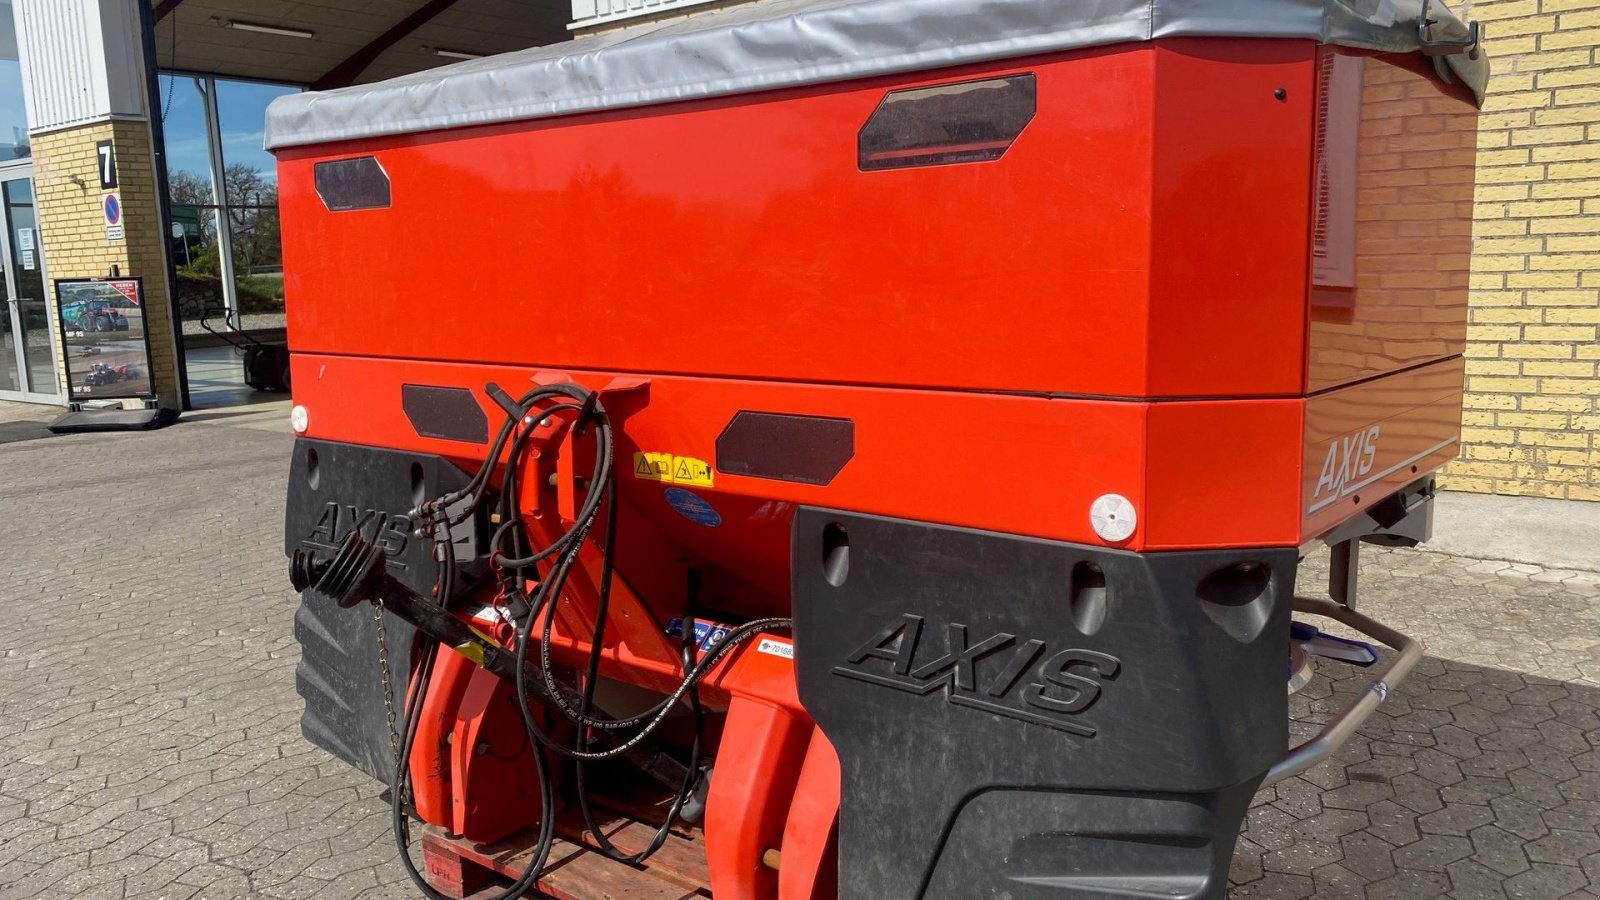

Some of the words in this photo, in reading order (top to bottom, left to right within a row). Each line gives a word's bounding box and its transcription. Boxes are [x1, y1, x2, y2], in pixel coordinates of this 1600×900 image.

[98, 145, 111, 184] 7
[1304, 425, 1380, 498] AXIS
[771, 644, 793, 657] 70168
[847, 612, 1122, 715] AXIS
